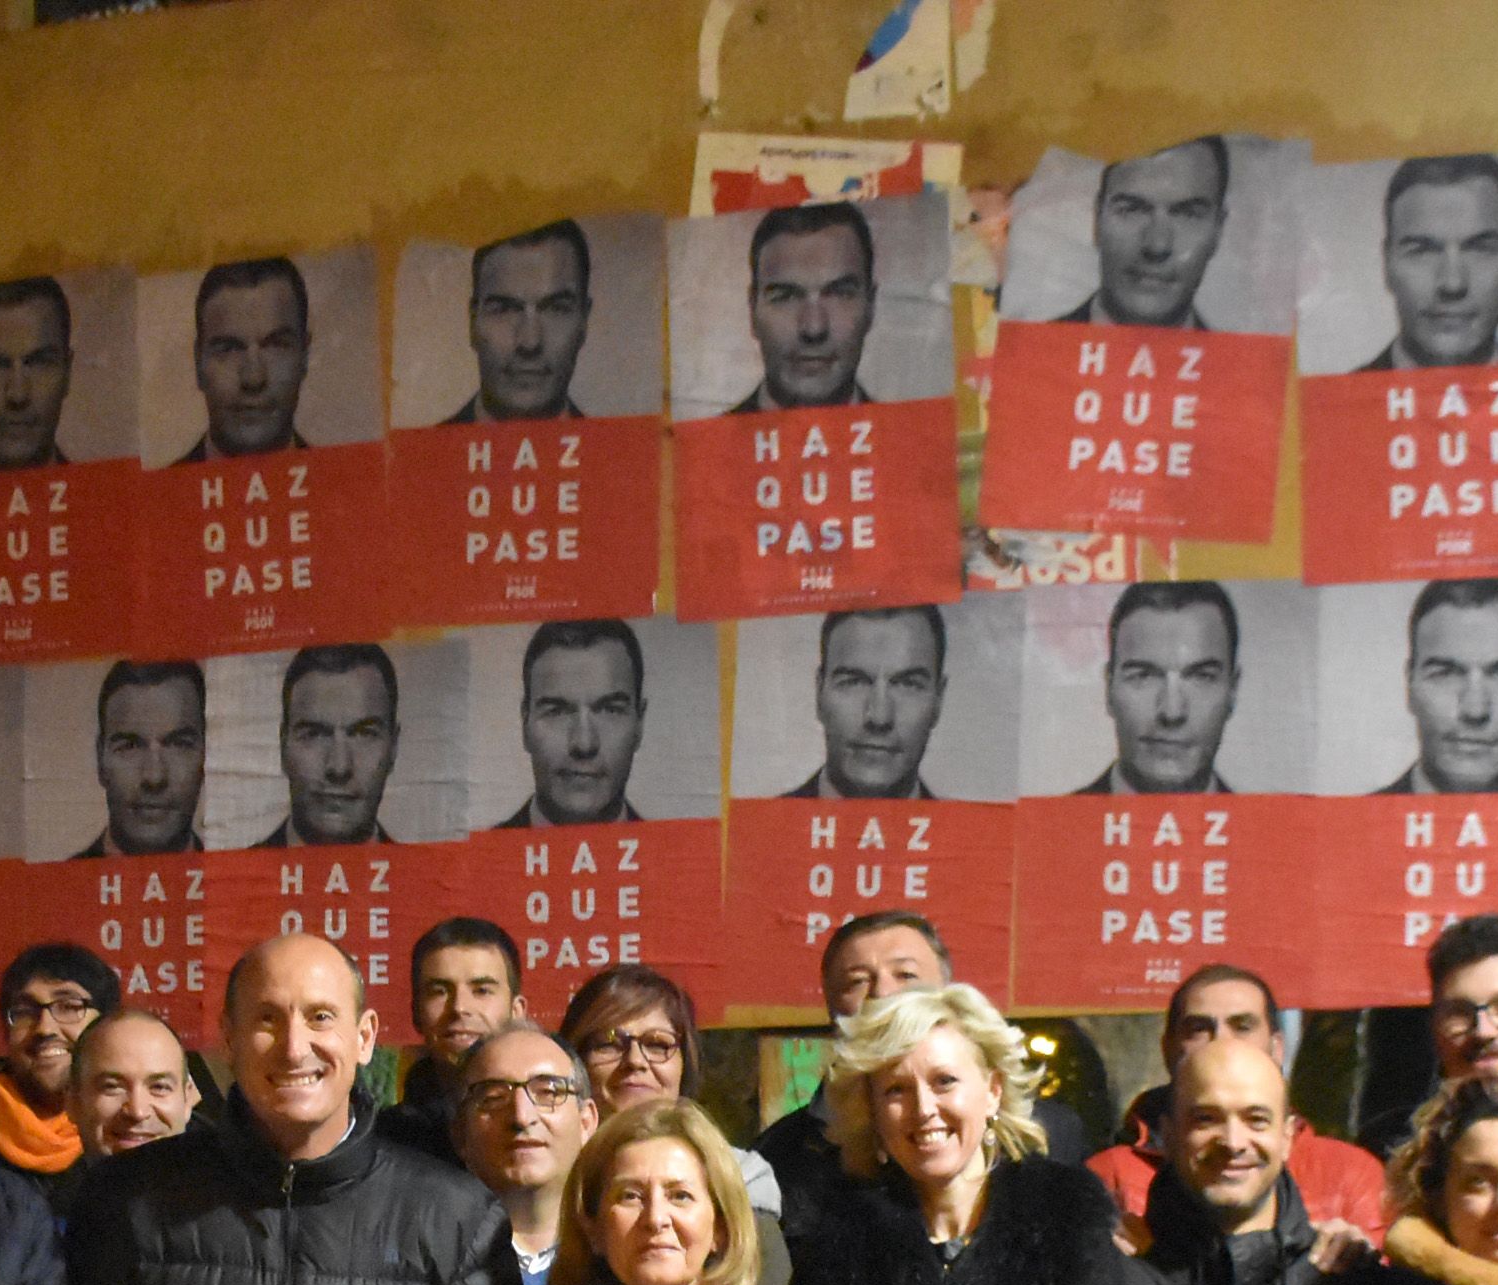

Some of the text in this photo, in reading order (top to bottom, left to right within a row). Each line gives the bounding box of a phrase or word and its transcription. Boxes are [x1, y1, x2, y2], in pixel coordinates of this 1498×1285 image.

[1080, 342, 1203, 381] HAZ
[1074, 390, 1199, 428] QUE
[468, 436, 580, 473] HAZ
[755, 422, 872, 462] HAZ
[1068, 438, 1193, 476] PASE
[202, 466, 308, 509] HAZ
[468, 482, 579, 517] QUE
[757, 468, 874, 508] QUE
[204, 512, 310, 553] QUE
[467, 528, 579, 564] PASE
[757, 516, 876, 556] PASE
[205, 557, 312, 598] PASE
[995, 533, 1126, 588] PSO
[810, 816, 931, 851] HAZ
[1104, 811, 1229, 846] HAZ
[526, 839, 639, 876] HAZ
[100, 870, 204, 905] HAZ
[281, 860, 389, 895] HAZ
[808, 865, 929, 899] QUE
[1103, 861, 1228, 895] QUE
[526, 886, 640, 923] QUE
[101, 914, 204, 950] QUE
[280, 908, 390, 939] QUE
[1101, 909, 1227, 944] PASE
[527, 933, 640, 969] PASE
[115, 959, 203, 994] ASE
